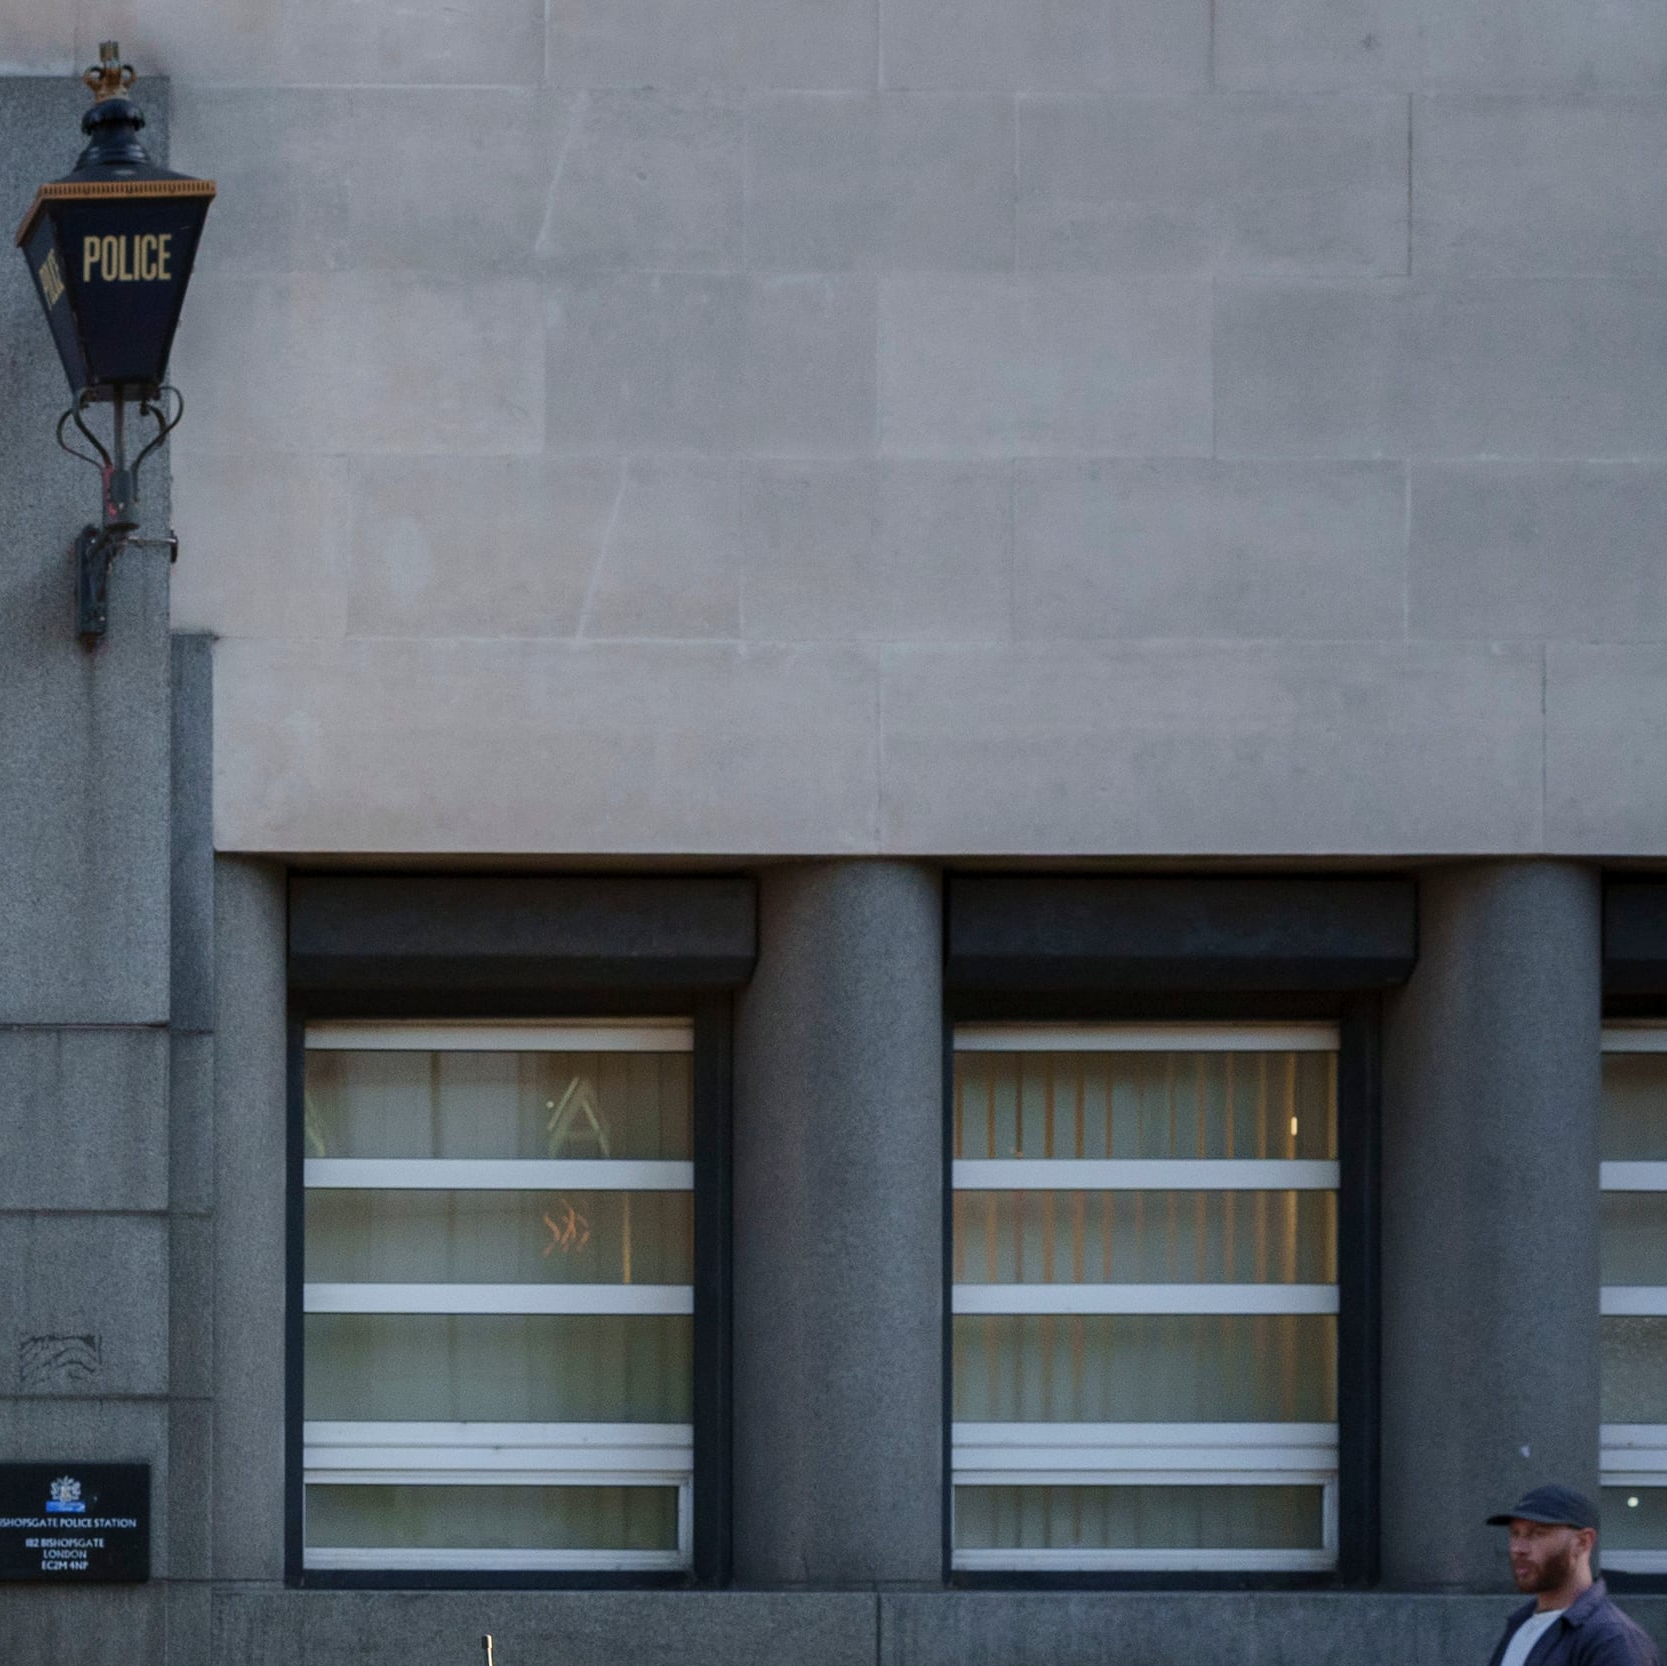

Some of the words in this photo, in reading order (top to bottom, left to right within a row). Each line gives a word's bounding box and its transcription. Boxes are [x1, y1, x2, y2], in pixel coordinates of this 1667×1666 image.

[83, 233, 172, 283] POLICE
[60, 1518, 92, 1528] POLICE
[94, 1518, 137, 1528] STATION
[41, 1537, 105, 1548] BISHOPSGATE
[43, 1549, 88, 1559] LONDON
